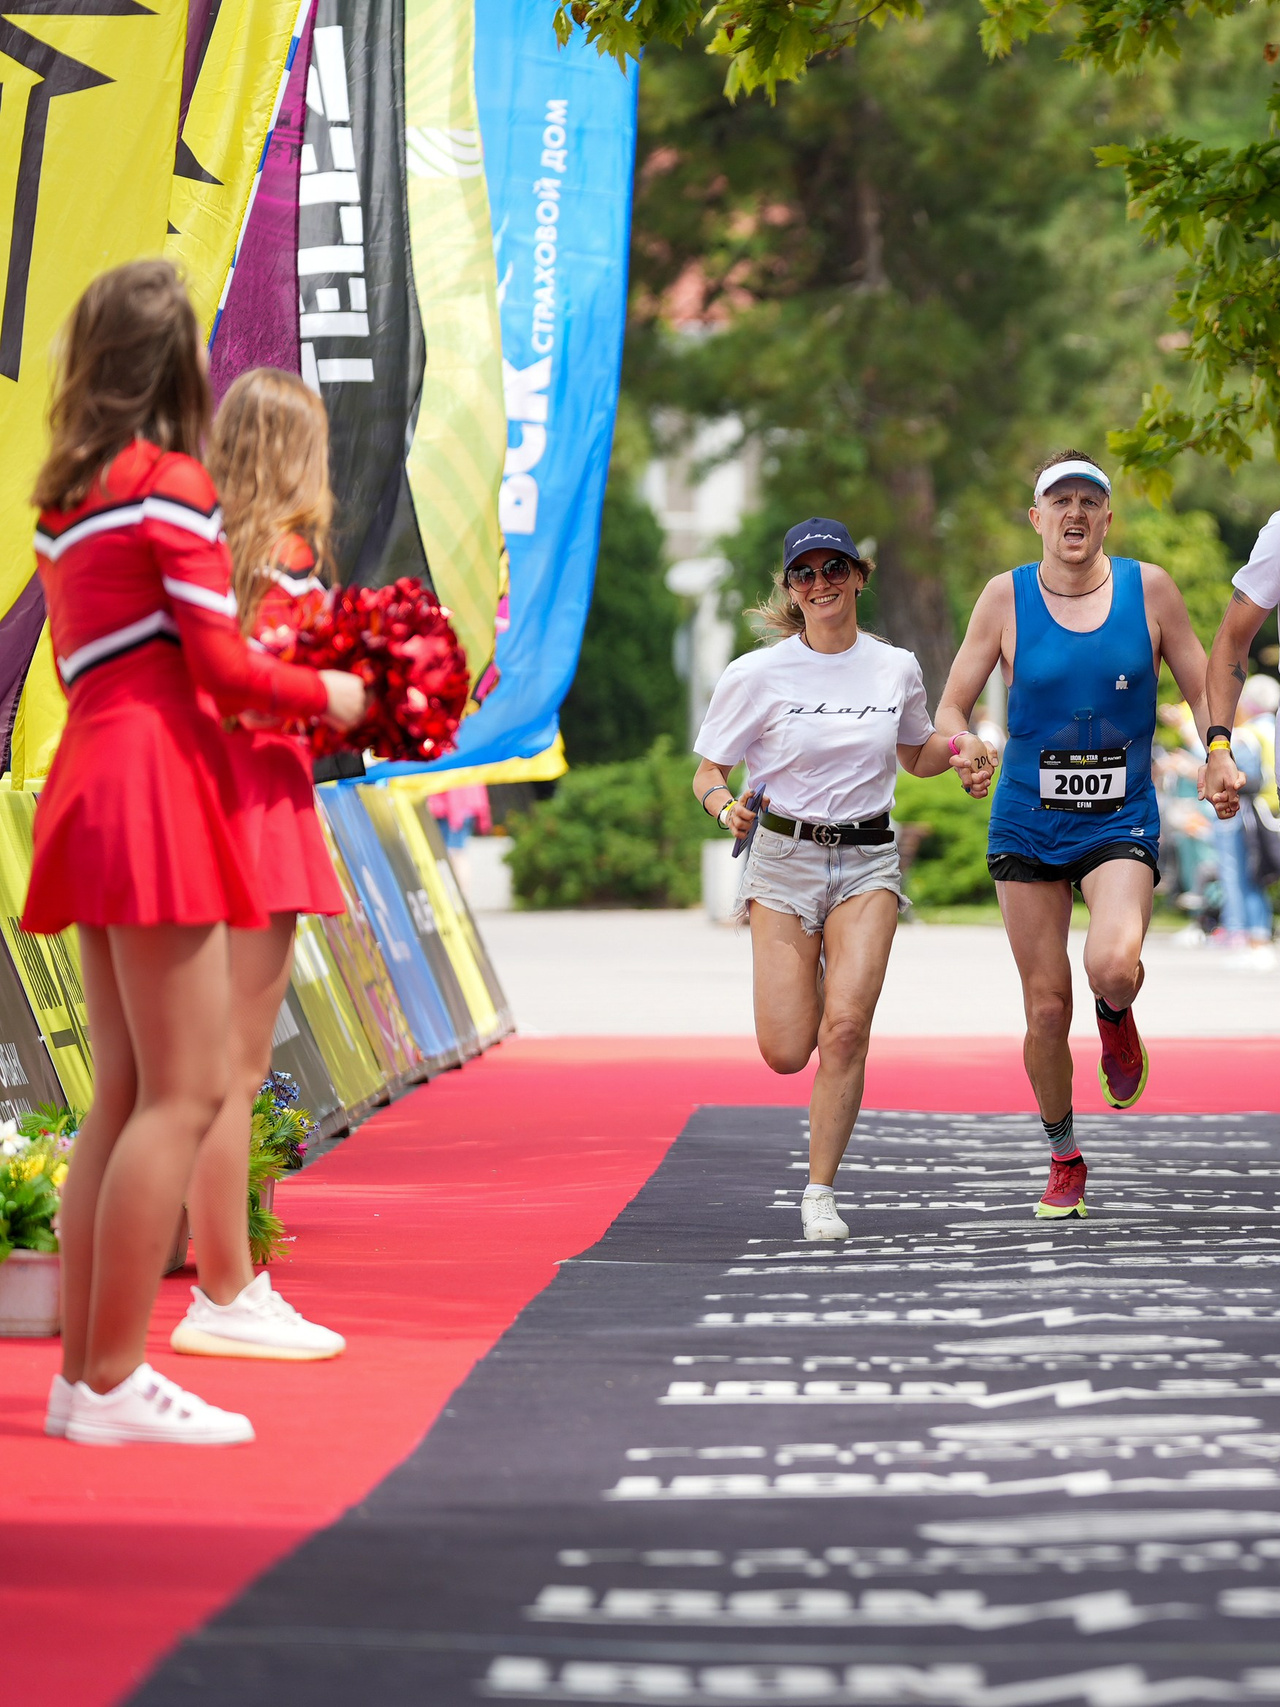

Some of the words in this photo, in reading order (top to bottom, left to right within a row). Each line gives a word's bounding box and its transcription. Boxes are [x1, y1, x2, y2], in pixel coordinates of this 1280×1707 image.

[540, 99, 569, 174] ДОМ
[531, 177, 561, 354] СТРАХОВОЙ
[1055, 774, 1113, 796] 2007
[701, 1308, 984, 1323] IRON
[665, 1381, 987, 1397] IRON
[614, 1471, 988, 1498] IRON
[534, 1584, 985, 1621] IRON
[486, 1655, 984, 1701] IRON
